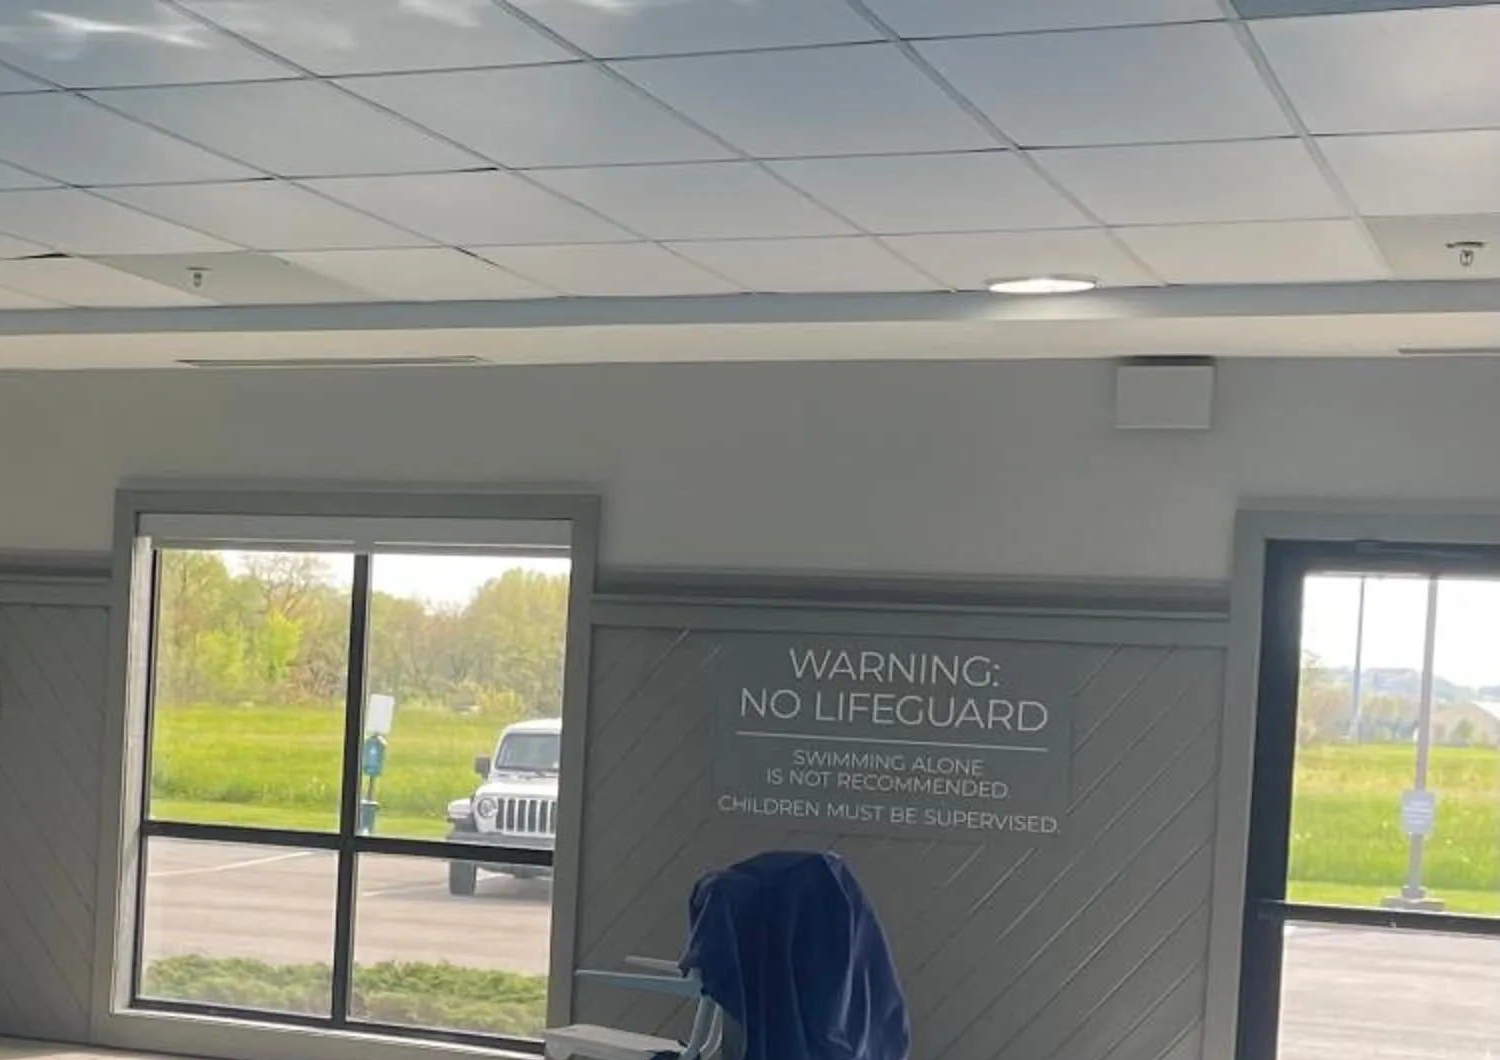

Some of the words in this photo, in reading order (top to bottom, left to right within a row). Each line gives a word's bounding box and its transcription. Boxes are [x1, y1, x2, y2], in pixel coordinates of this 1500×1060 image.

[789, 648, 1000, 687] WARNING:
[740, 687, 800, 719] NO
[815, 691, 1048, 732] LIFEGUARD
[766, 768, 784, 785] IS
[789, 769, 831, 788] NOT
[794, 749, 906, 772] SWIMMING
[911, 756, 984, 777] ALONE
[718, 795, 819, 817] CHILDREN
[827, 802, 884, 821] MUST
[890, 807, 917, 823] BE
[924, 808, 1061, 834] SUPERVISED.
